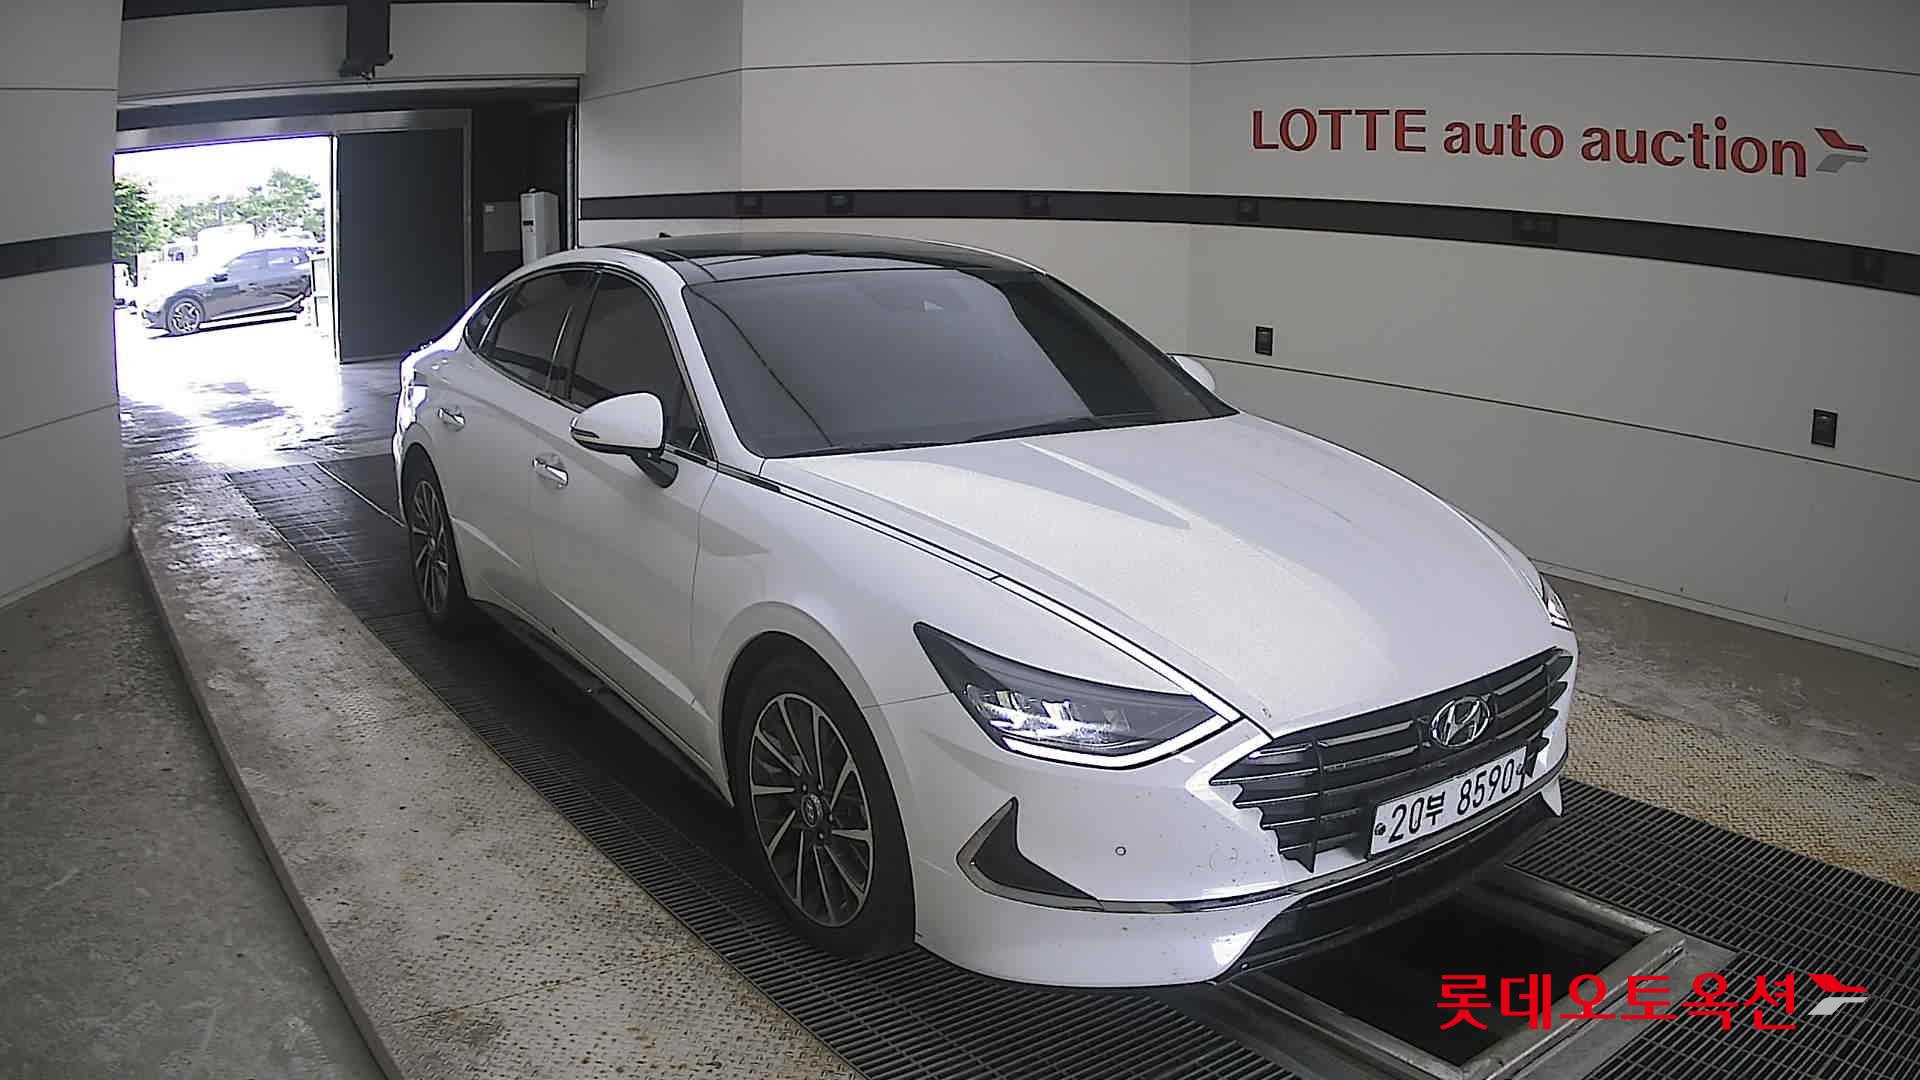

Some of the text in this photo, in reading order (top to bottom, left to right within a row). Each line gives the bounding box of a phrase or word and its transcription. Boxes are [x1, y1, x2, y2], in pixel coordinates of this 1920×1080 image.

[1252, 108, 1808, 178] LOTTE auto auction
[1388, 759, 1514, 843] 20부 8590
